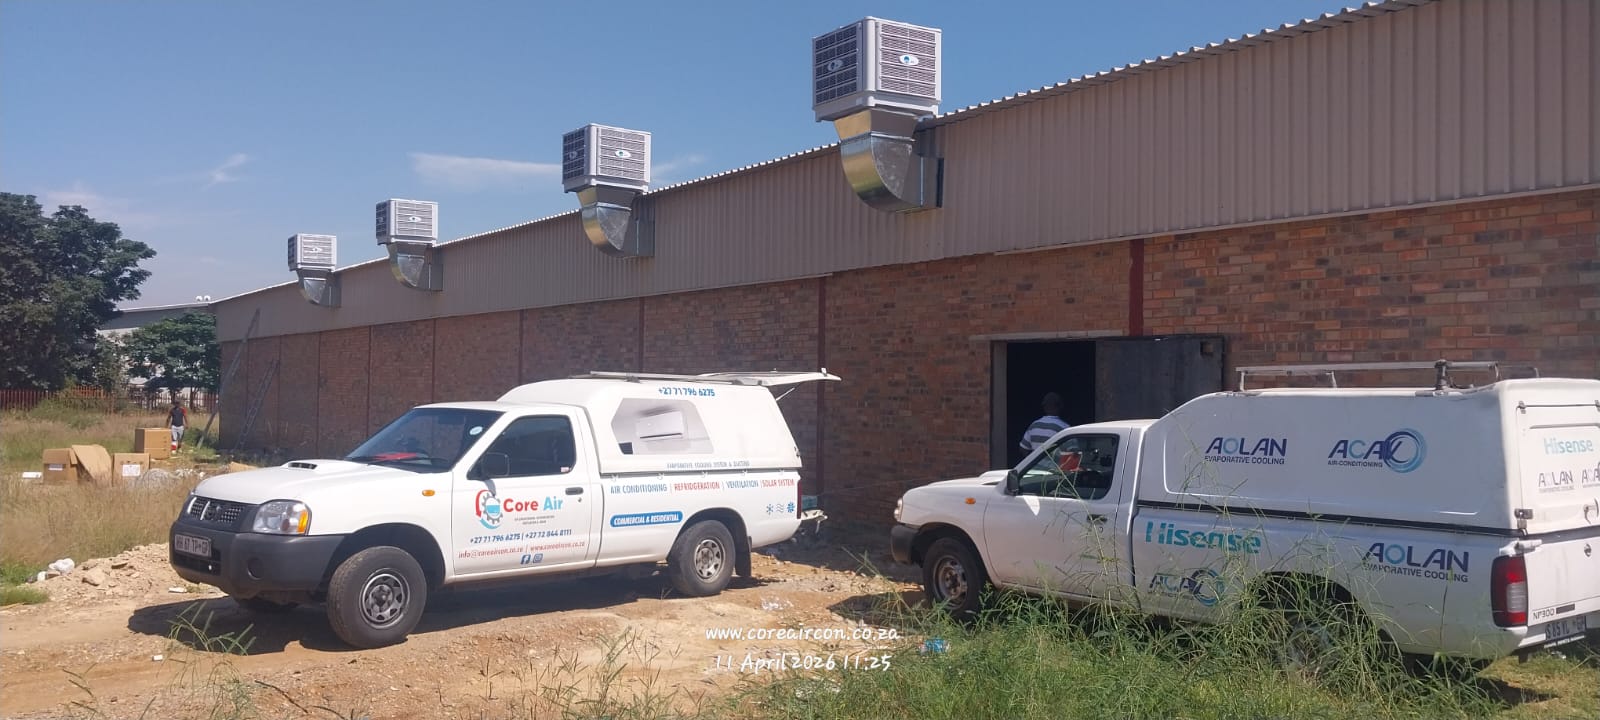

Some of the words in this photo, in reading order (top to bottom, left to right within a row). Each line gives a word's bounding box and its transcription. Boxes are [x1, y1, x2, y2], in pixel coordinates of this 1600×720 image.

[1205, 437, 1287, 457] AOLAN
[1543, 437, 1594, 454] Hisense
[1205, 455, 1250, 464] EVAPORATIVE
[1251, 457, 1285, 465] COOLING
[610, 485, 621, 494] AIR
[622, 484, 668, 494] CONDITIONING
[727, 480, 759, 488] VENTILATION
[762, 479, 778, 488] SOLAR
[778, 478, 795, 487] SYSTEM
[1538, 470, 1574, 487] ALAN
[503, 498, 539, 513] Core
[543, 496, 563, 511] Air
[613, 516, 645, 526] COMMERCIAL
[470, 536, 483, 544] +27
[492, 534, 504, 542] 796
[505, 533, 521, 541] 6275
[525, 532, 537, 540] +27
[1145, 521, 1261, 554] Hisense
[1361, 542, 1470, 573] AOLAN
[1424, 569, 1469, 583] COOLNG
